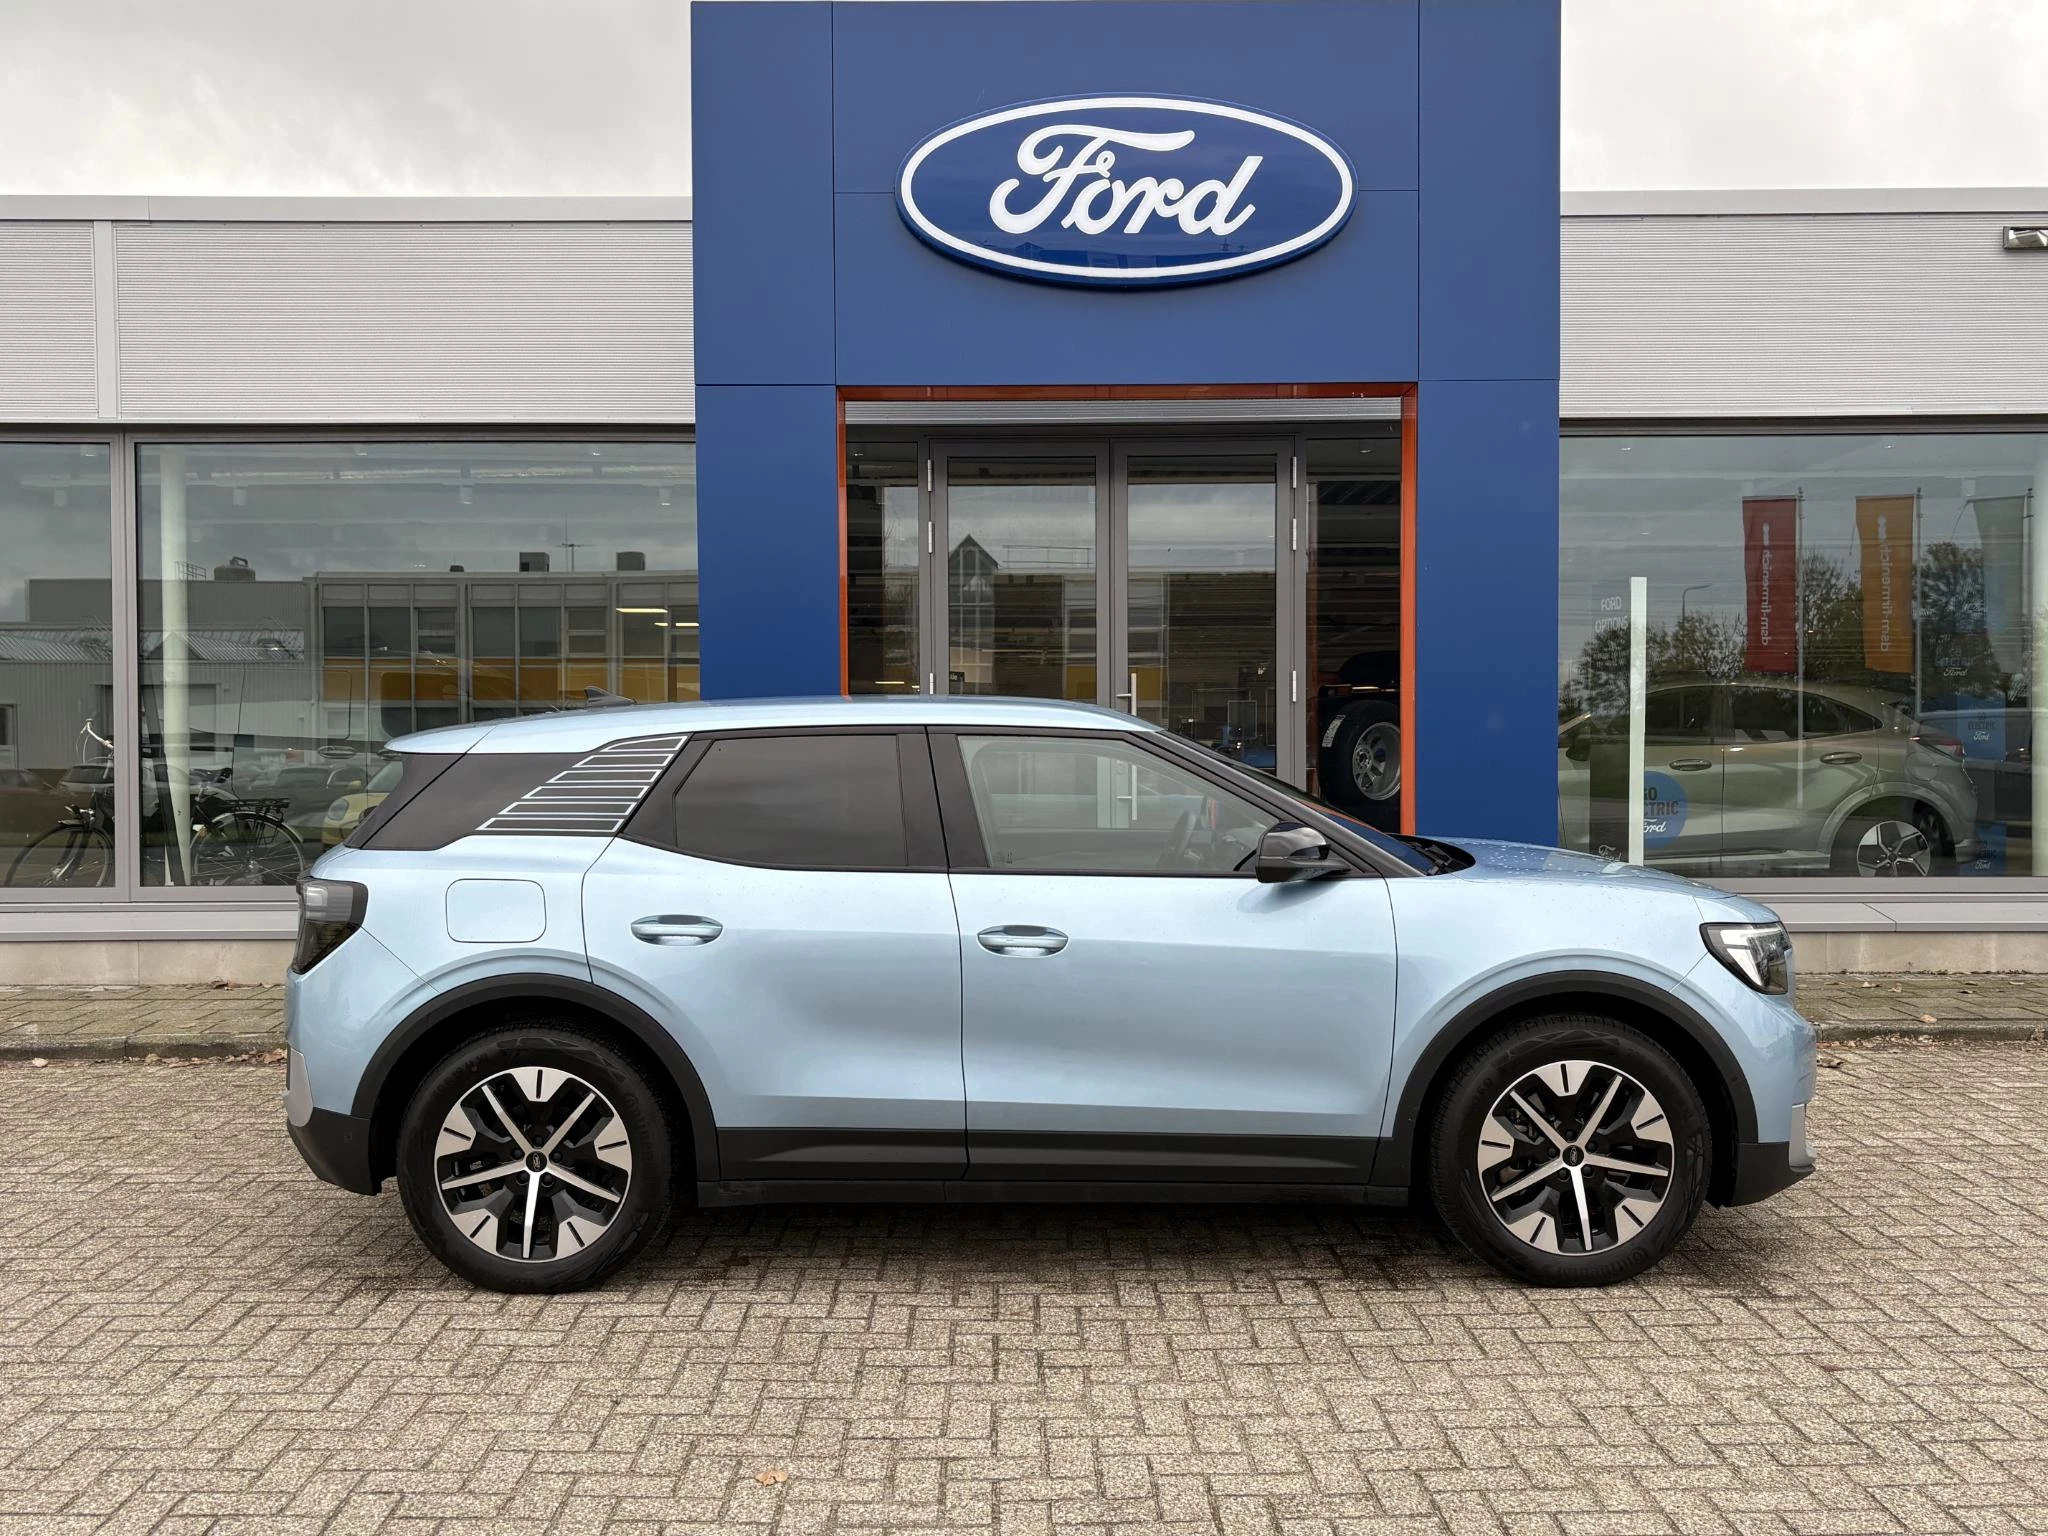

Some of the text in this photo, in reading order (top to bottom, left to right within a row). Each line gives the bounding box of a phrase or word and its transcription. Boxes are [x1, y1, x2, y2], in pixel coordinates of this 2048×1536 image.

[990, 124, 1263, 235] Ford
[1600, 595, 1622, 612] FORD
[1594, 615, 1628, 633] OPTIONS
[1643, 817, 1667, 833] ord
